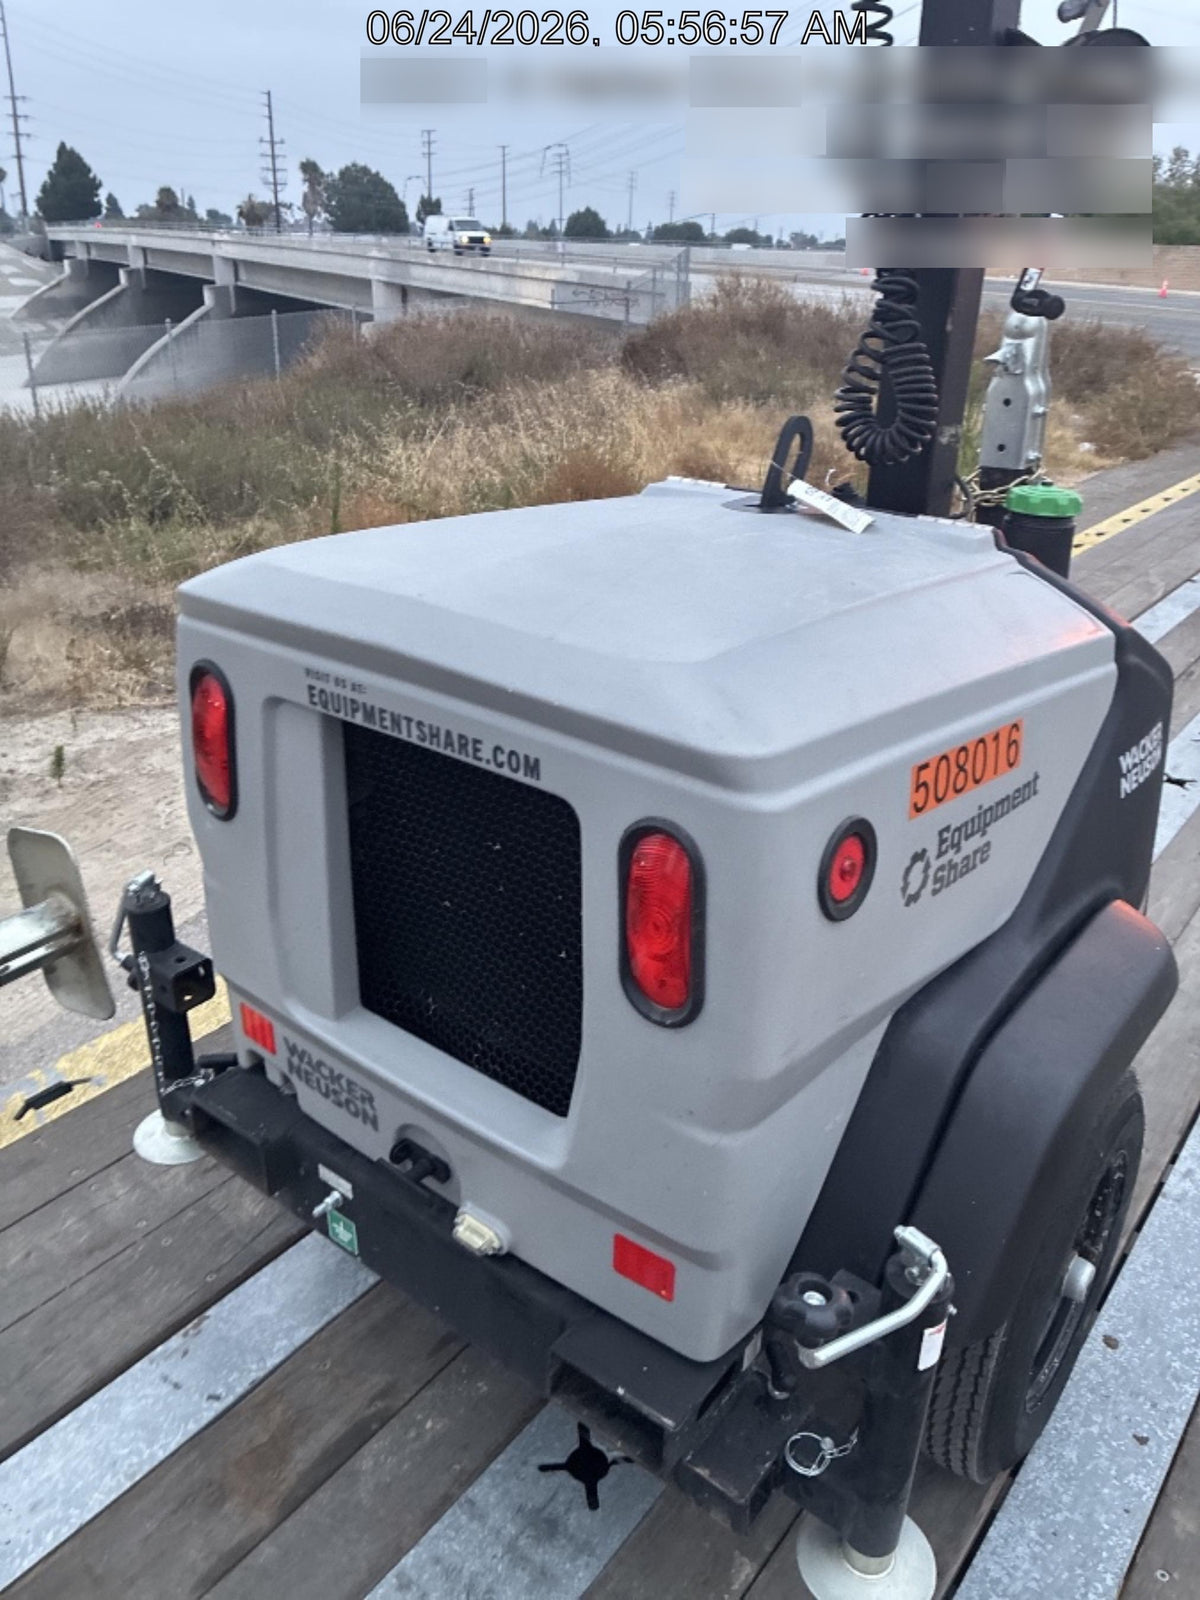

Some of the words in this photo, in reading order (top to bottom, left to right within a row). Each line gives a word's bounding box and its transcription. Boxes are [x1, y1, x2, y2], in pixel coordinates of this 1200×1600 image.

[307, 684, 541, 780] EQUIPMENTSHARE.COM
[912, 722, 1020, 813] 508016
[935, 771, 1040, 860] Equipment
[931, 840, 992, 896] Share
[284, 1036, 377, 1112] WACKER
[287, 1055, 379, 1132] NEUSON
